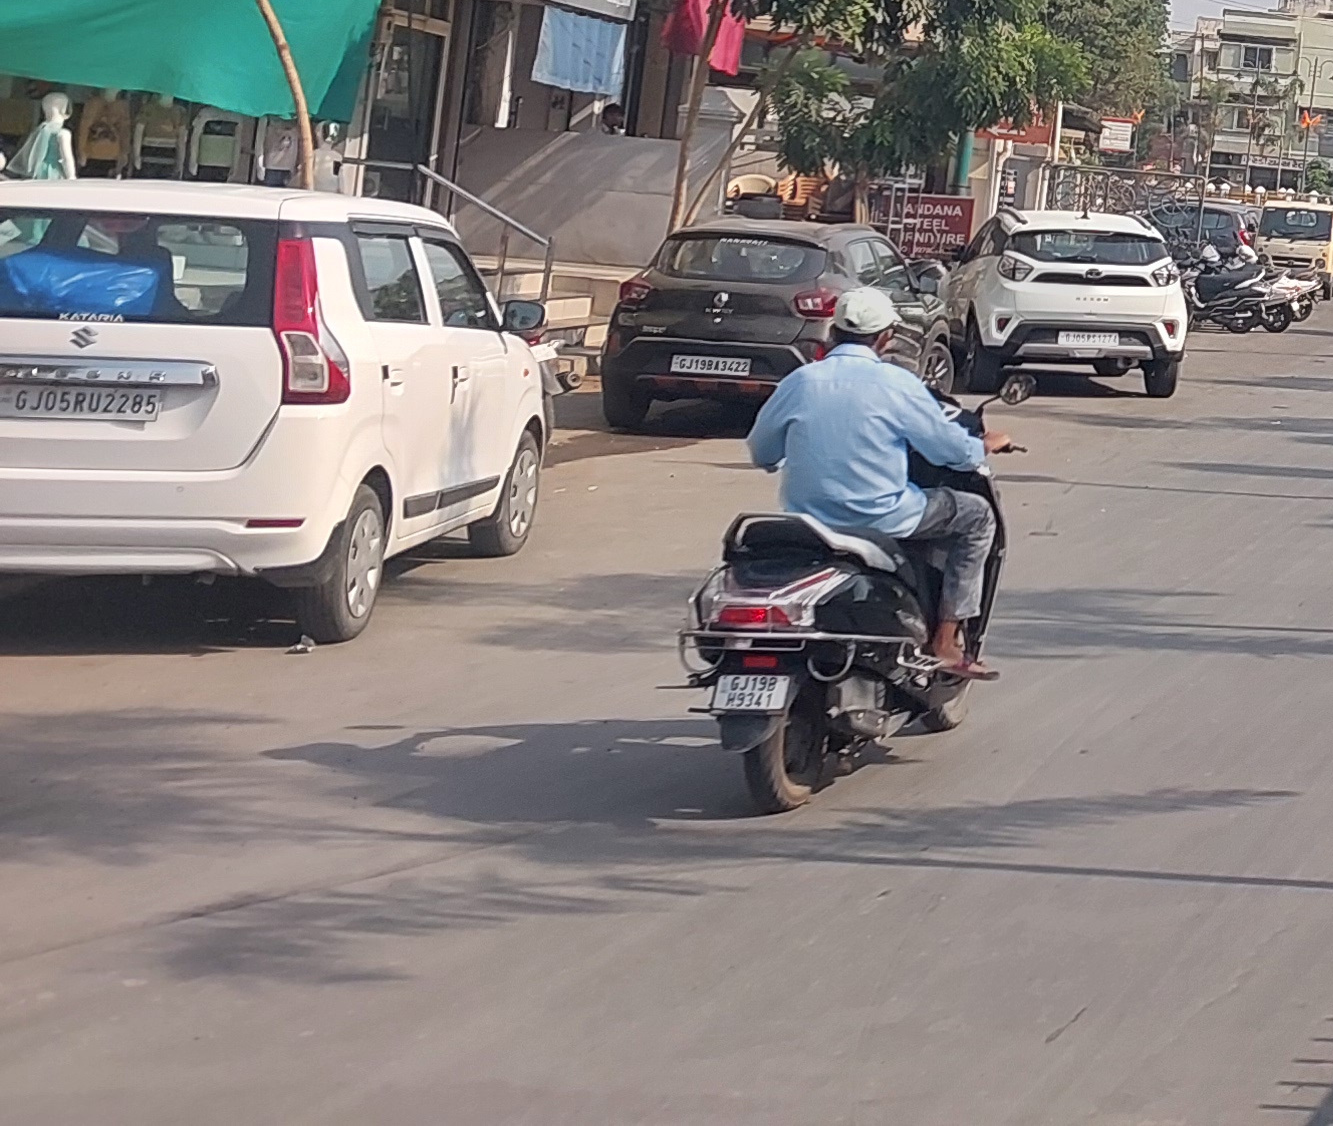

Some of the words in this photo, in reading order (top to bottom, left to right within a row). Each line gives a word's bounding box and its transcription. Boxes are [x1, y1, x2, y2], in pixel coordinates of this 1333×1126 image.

[58, 312, 125, 323] KATARIA
[679, 358, 749, 373] GJ19BA3422
[15, 389, 157, 415] GJ05RU2285
